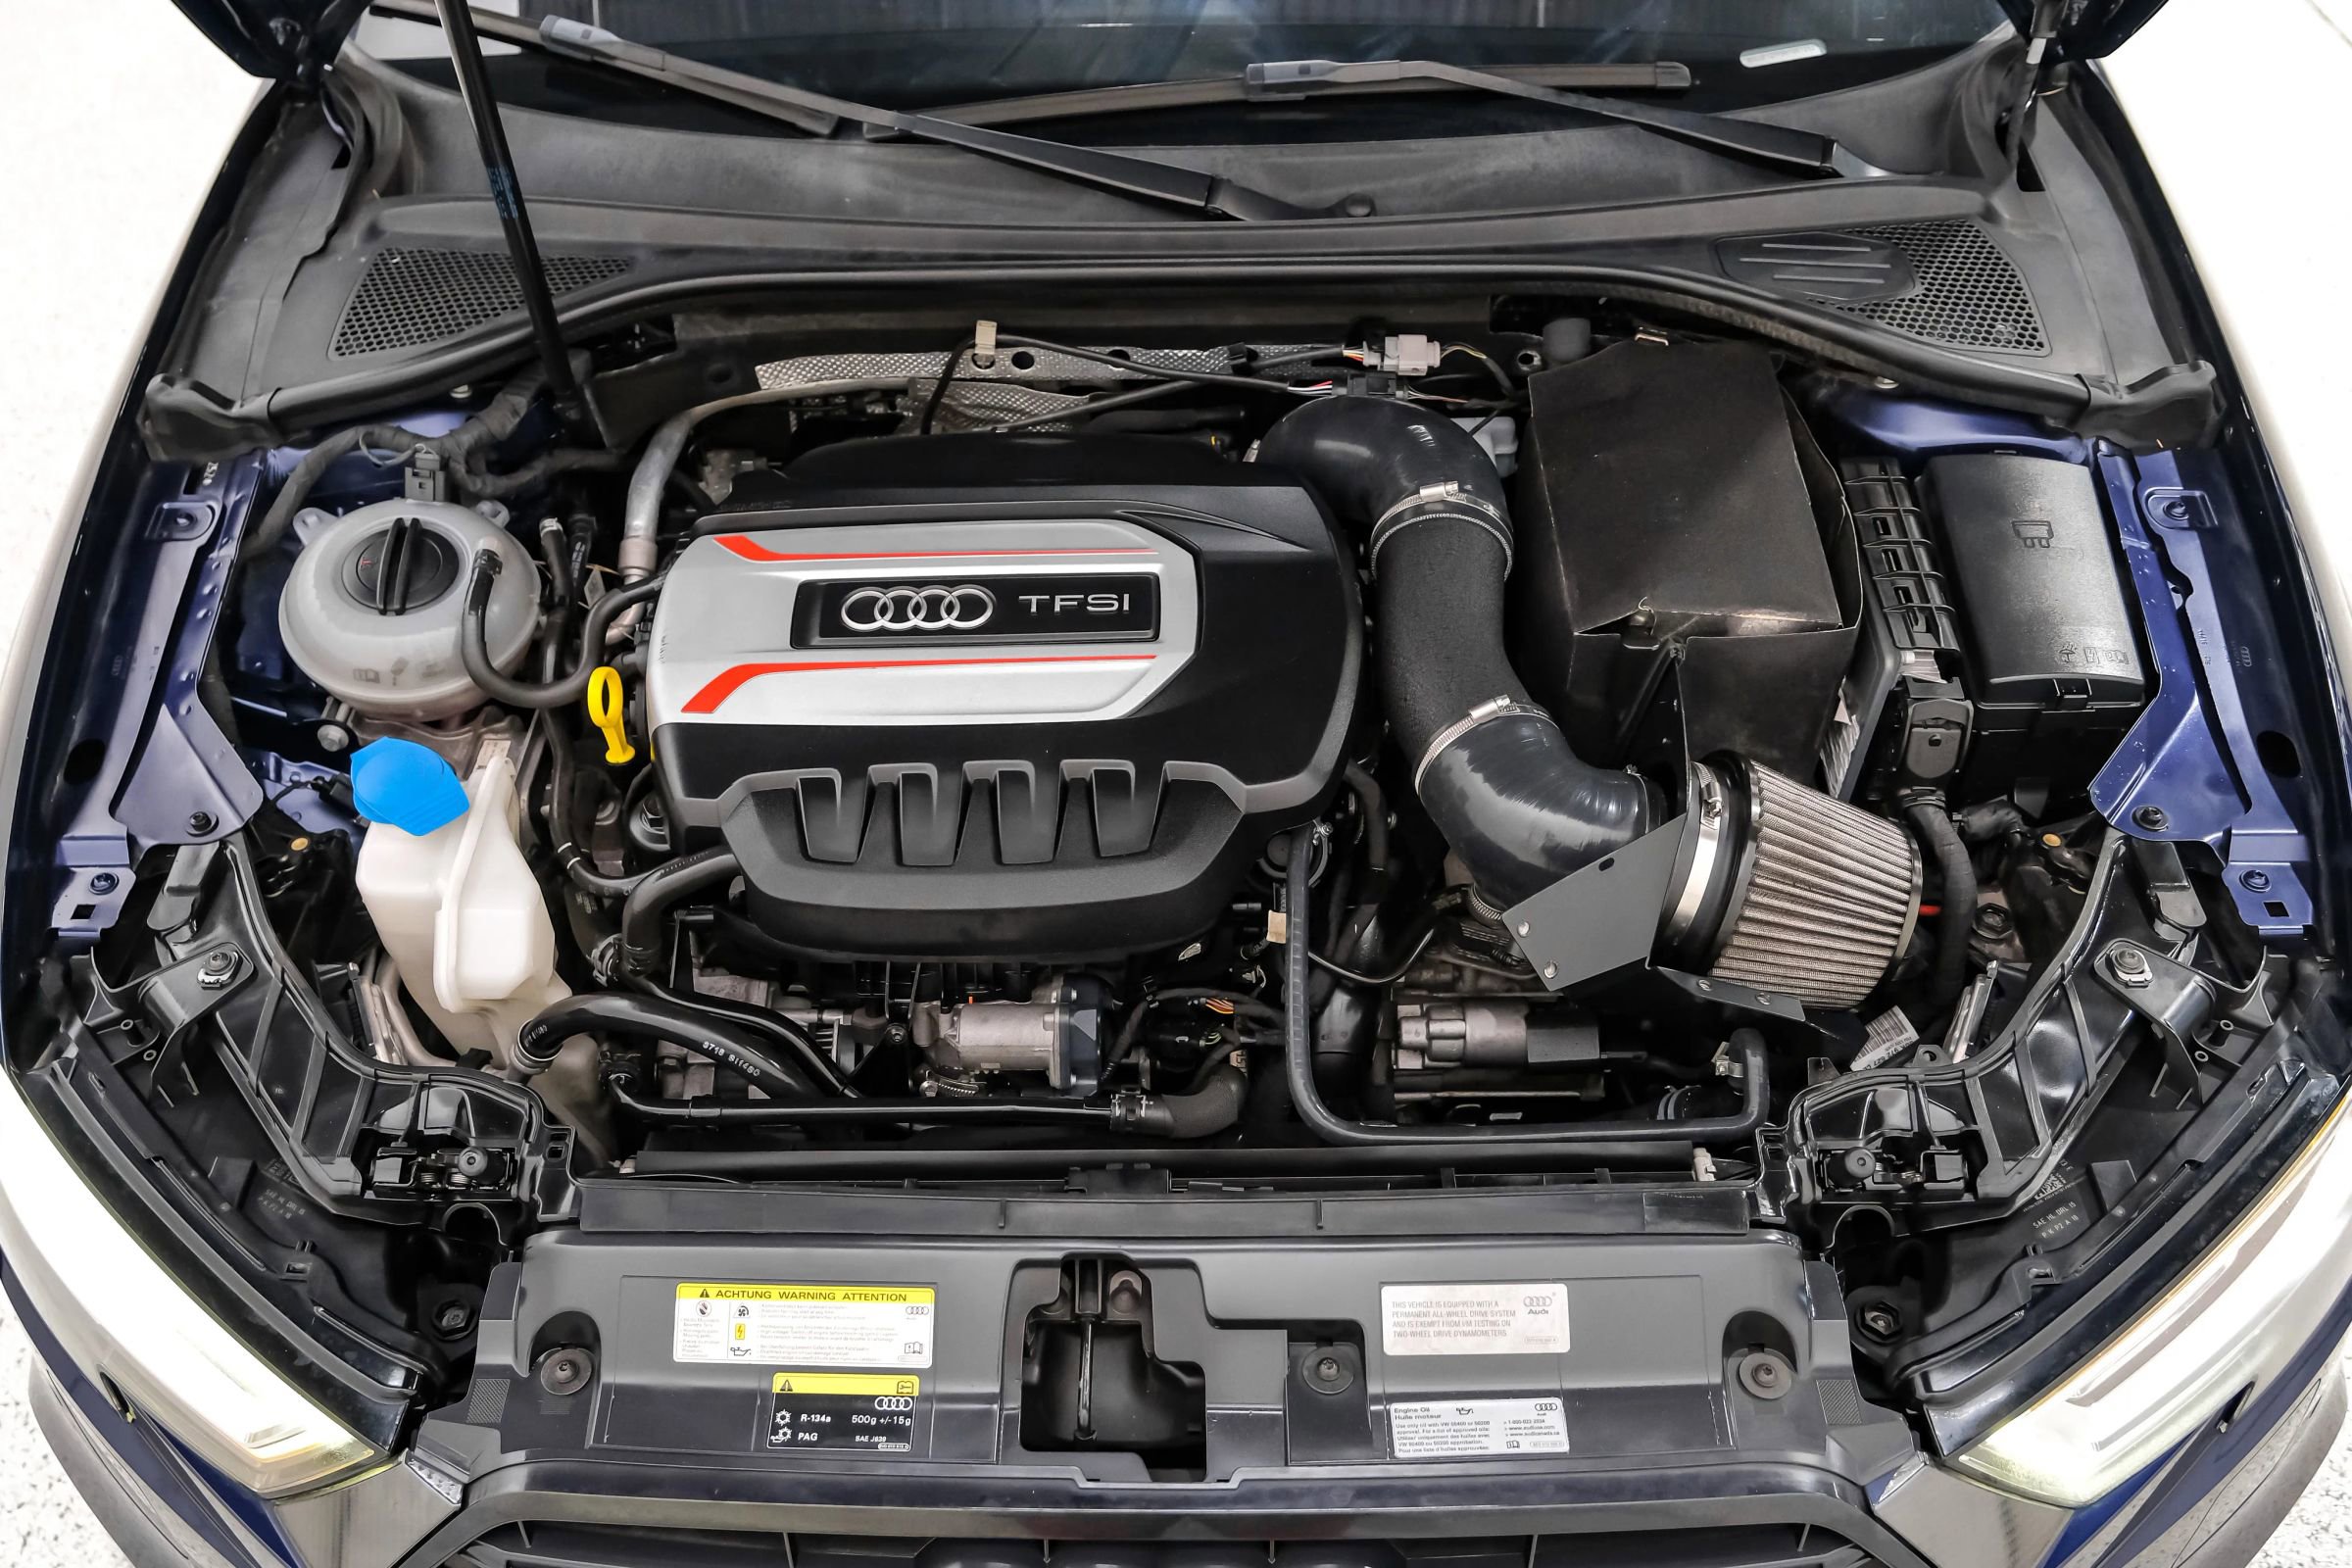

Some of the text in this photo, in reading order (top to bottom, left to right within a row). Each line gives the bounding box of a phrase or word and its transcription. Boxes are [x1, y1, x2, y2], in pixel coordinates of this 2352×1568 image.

[1018, 593, 1130, 613] TFSI
[2033, 1217, 2046, 1229] SAE
[715, 1290, 907, 1302] ACHTUNG WARNING ATTENTION
[1469, 1309, 1489, 1318] DRIVE
[1394, 1330, 1432, 1339] TWO-WHEEL
[1453, 1329, 1507, 1338] DYNAMOMETERS
[801, 1413, 831, 1423] R-134a
[851, 1414, 877, 1426] 500g
[797, 1432, 819, 1442] PAG
